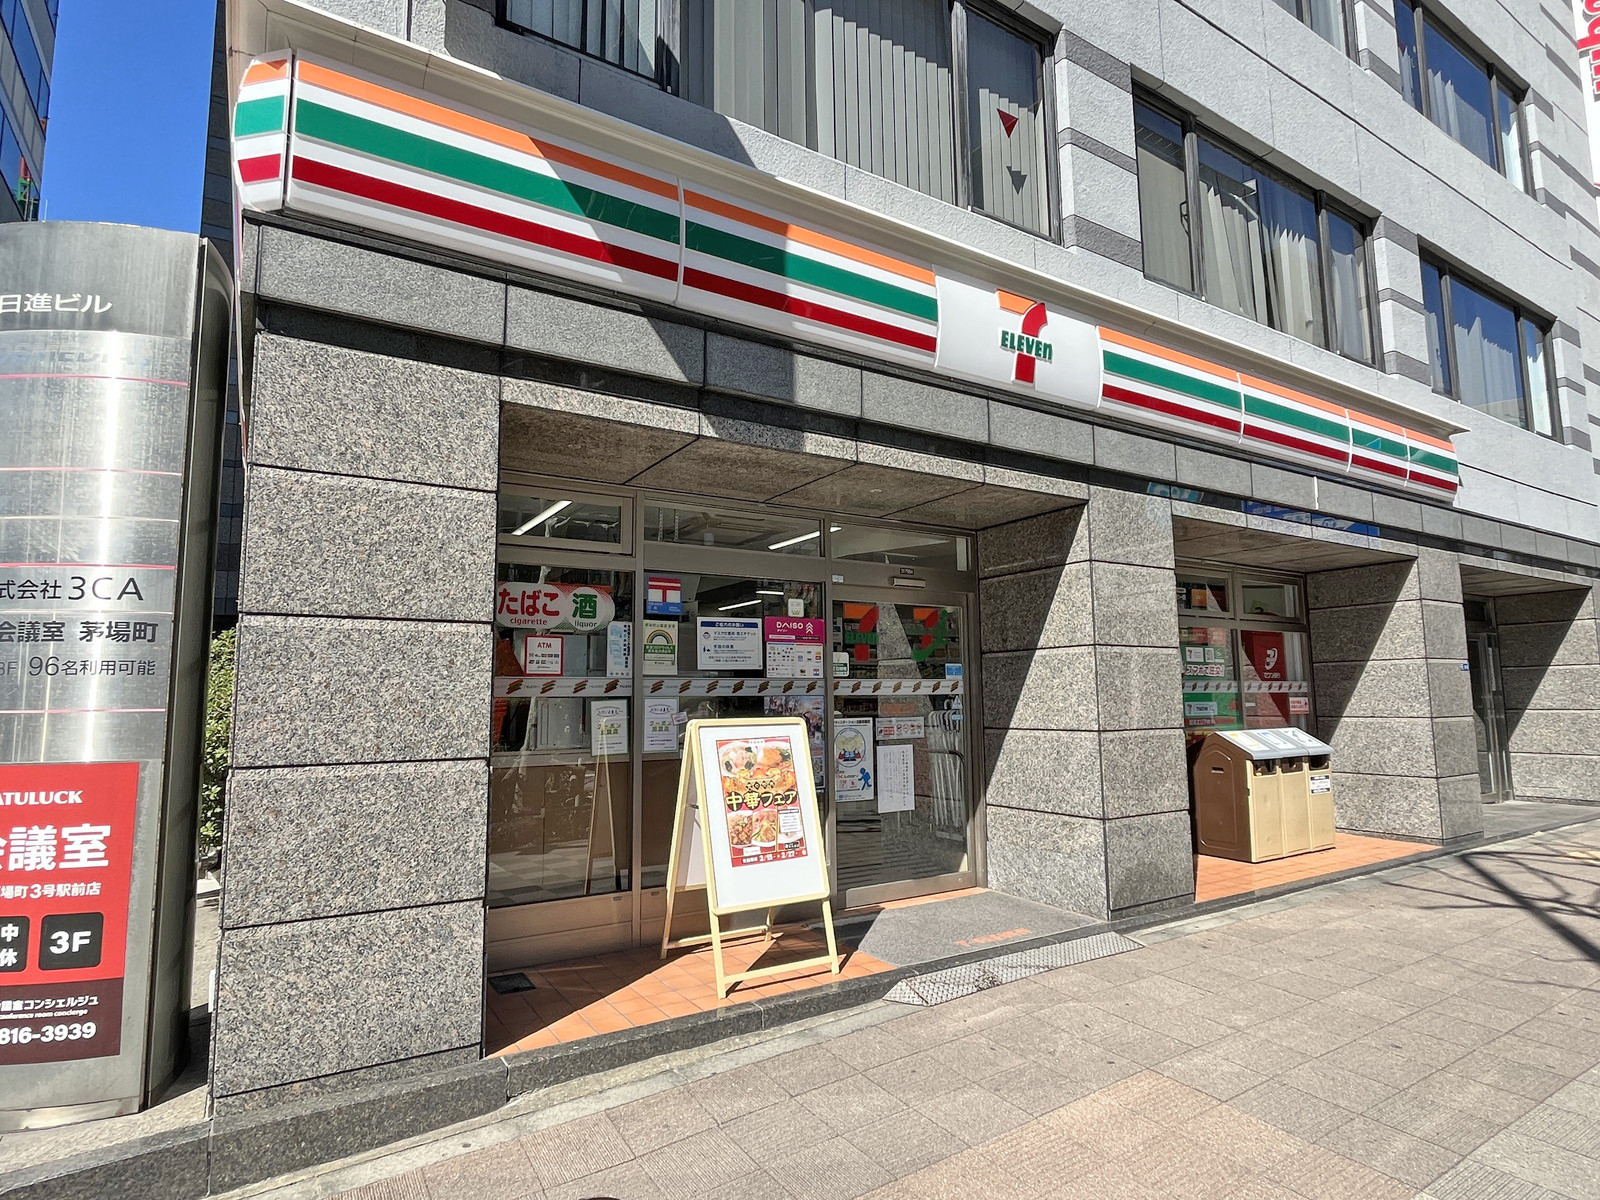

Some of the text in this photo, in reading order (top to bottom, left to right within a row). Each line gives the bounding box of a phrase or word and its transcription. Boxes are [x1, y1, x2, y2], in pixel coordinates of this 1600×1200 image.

[0, 292, 113, 314] 日進ビル
[498, 588, 598, 619] たばこ 酒
[79, 620, 158, 643] 茅場町
[509, 617, 598, 629] cigarette liquor
[776, 621, 804, 630] DAISO
[536, 641, 552, 650] ATM
[29, 656, 156, 677] 96名利用可能
[726, 788, 798, 811] 中華フェア
[0, 823, 111, 871] 議室
[0, 881, 102, 900] 場町3号駅前店
[49, 930, 92, 955] 3F
[0, 1021, 97, 1046] 816-3939
